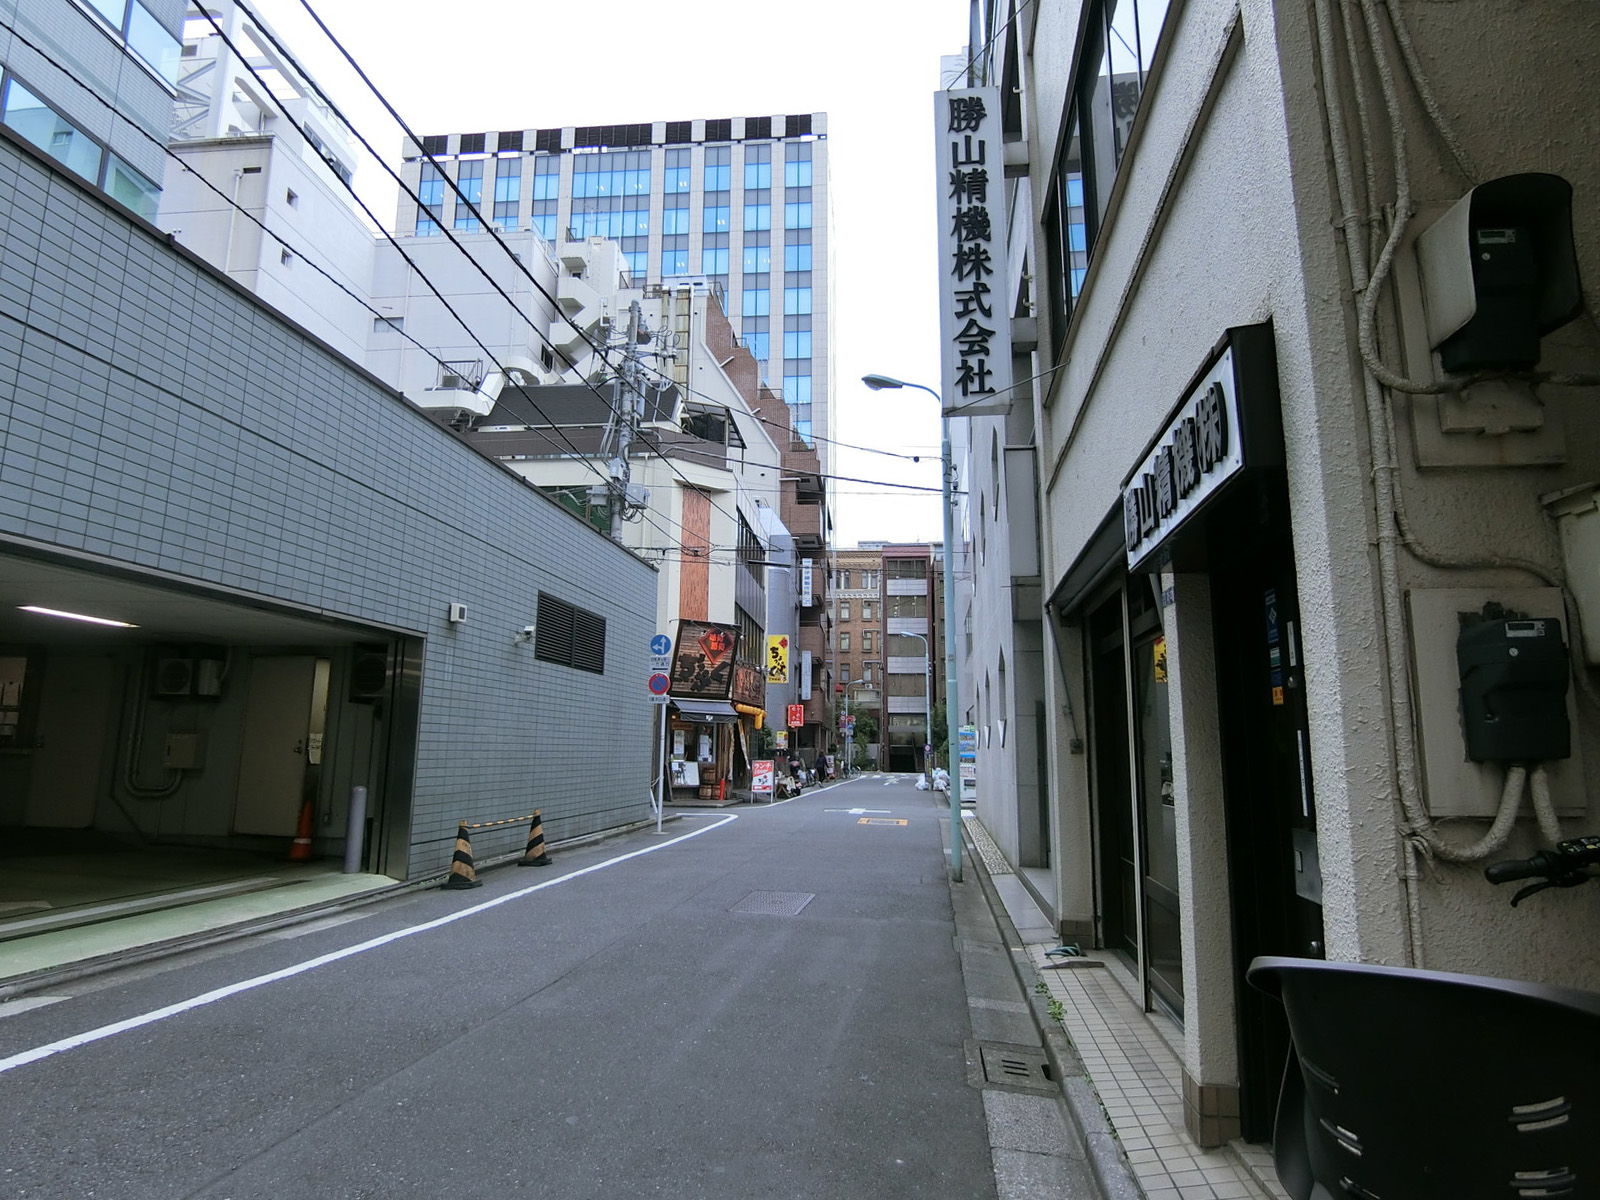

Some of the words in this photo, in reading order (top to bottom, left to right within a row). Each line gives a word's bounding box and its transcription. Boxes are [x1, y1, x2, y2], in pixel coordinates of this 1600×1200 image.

[948, 96, 996, 397] 勝山精機株式会社
